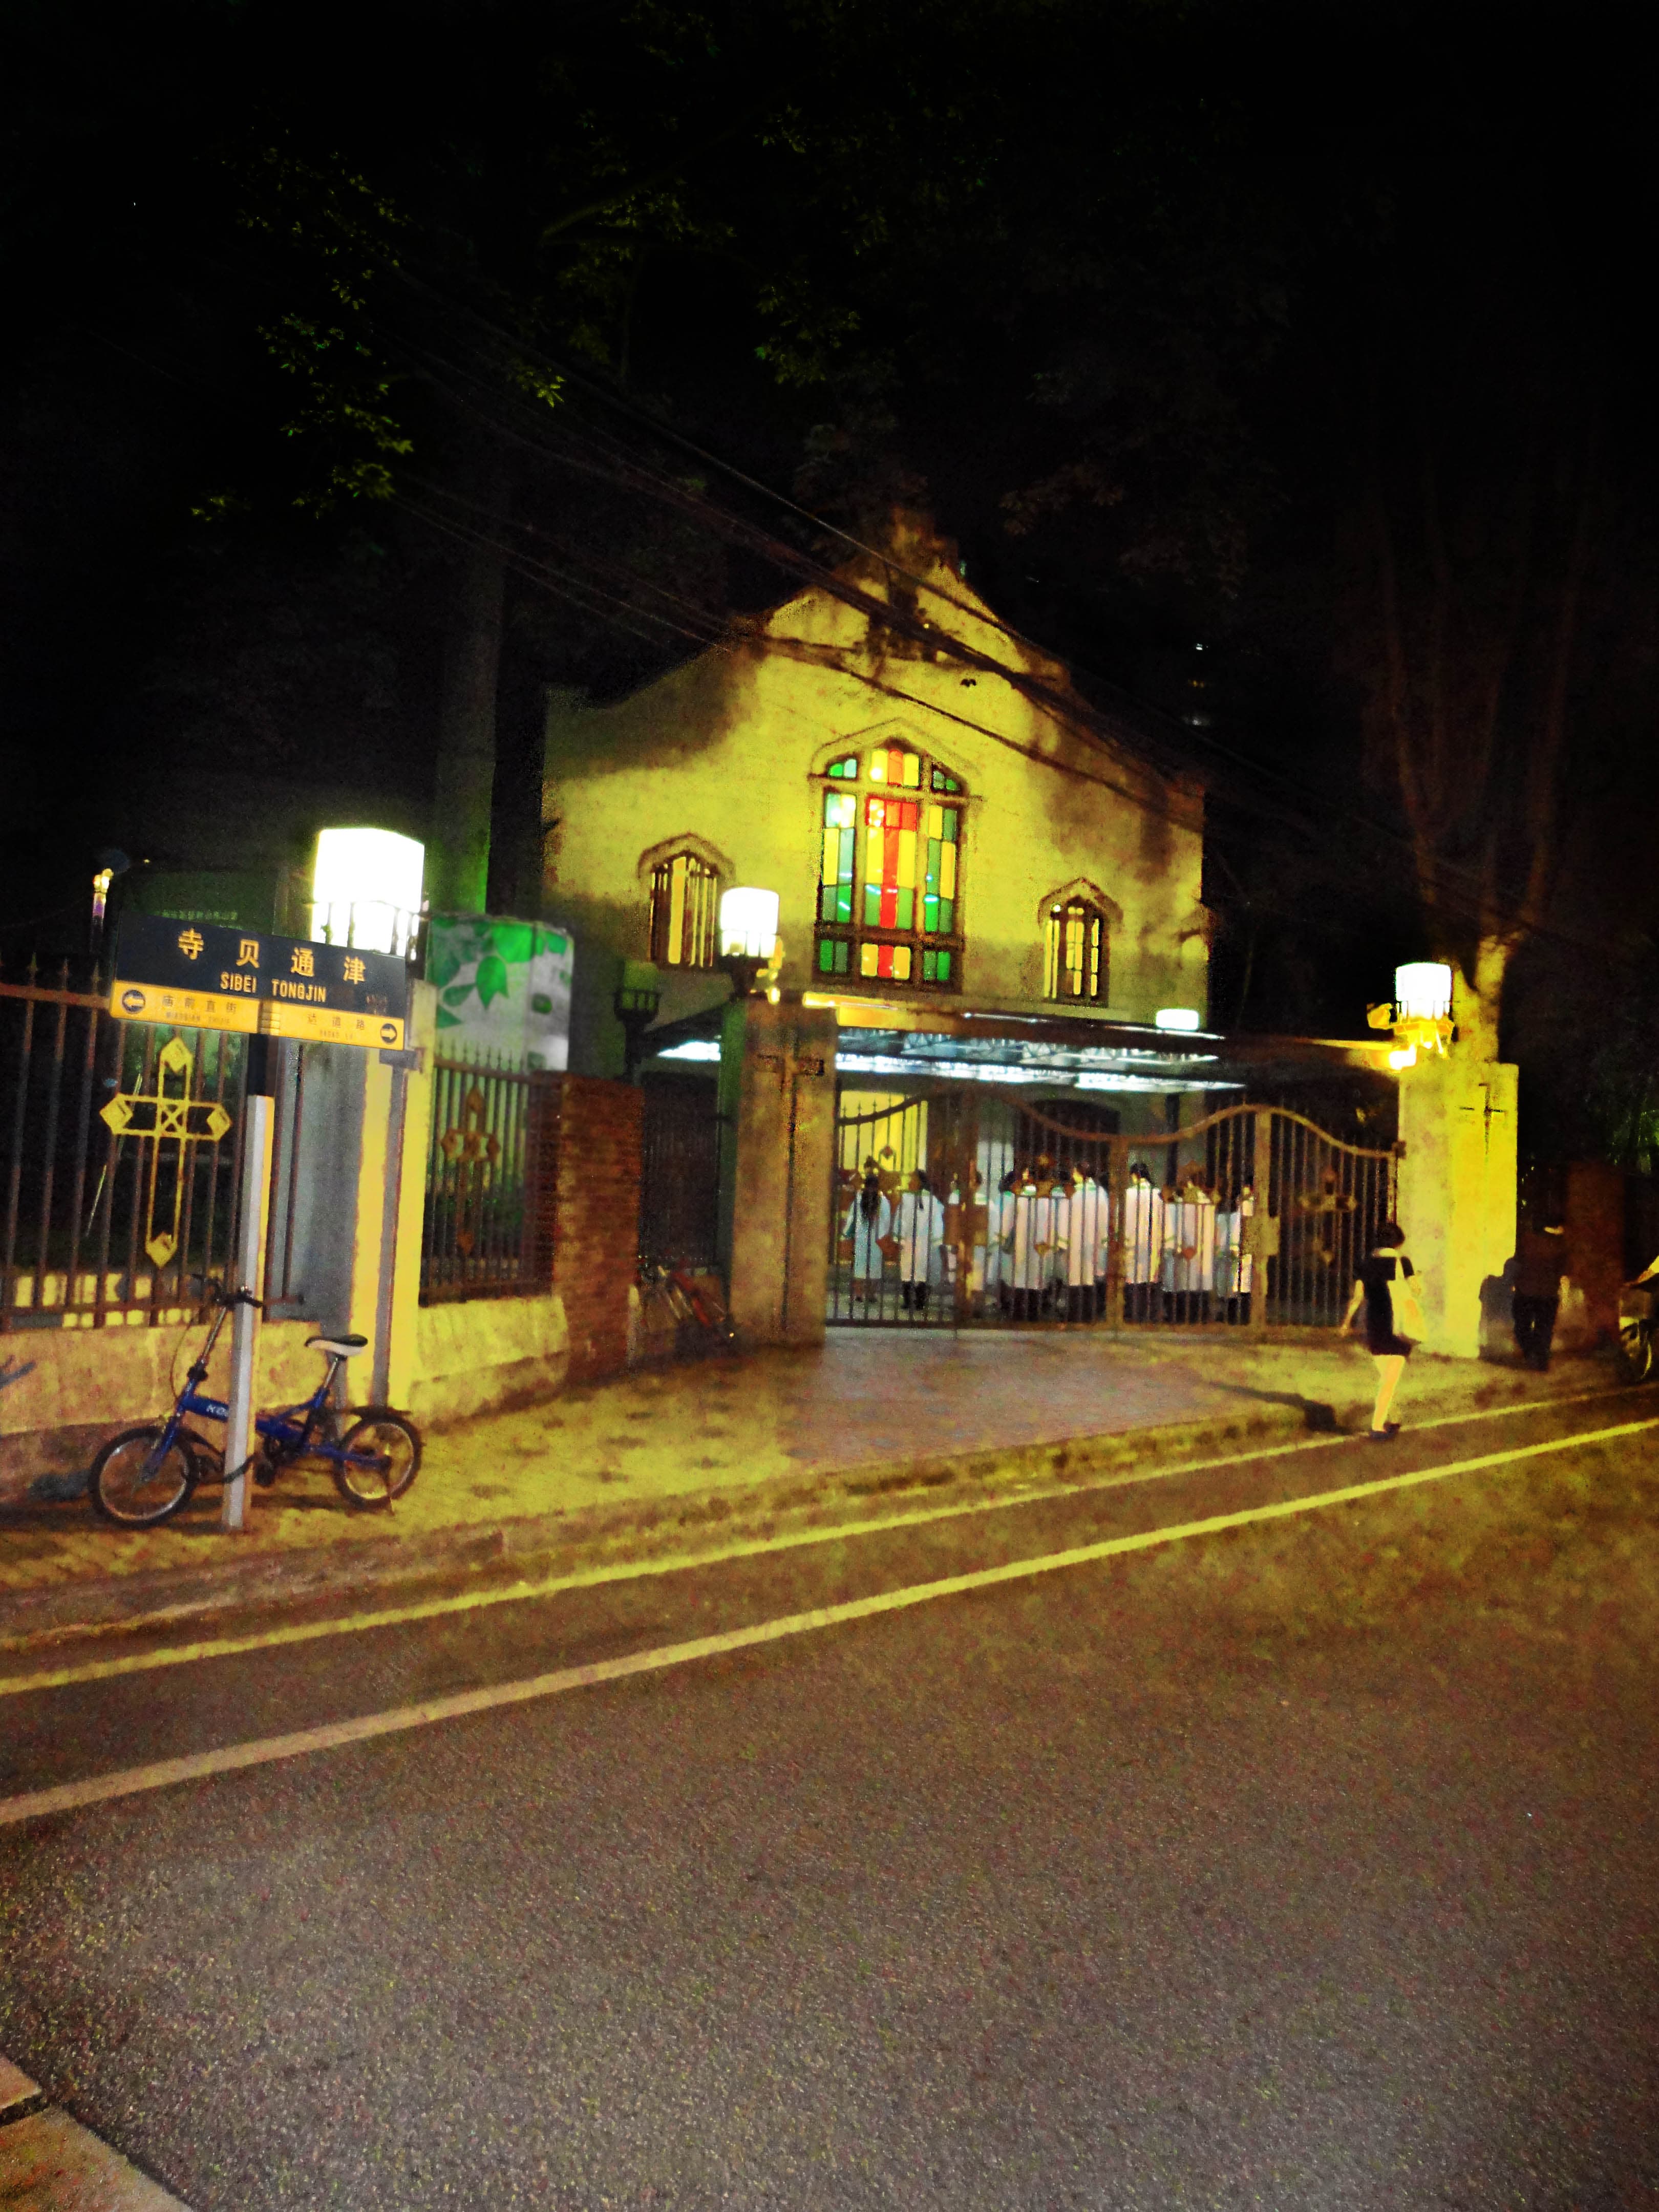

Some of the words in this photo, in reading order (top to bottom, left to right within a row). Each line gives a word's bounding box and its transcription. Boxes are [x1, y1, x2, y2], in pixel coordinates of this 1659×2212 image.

[178, 927, 367, 985] 寺贝通津
[220, 971, 258, 993] SIBEI
[271, 979, 327, 1003] TONGJIN
